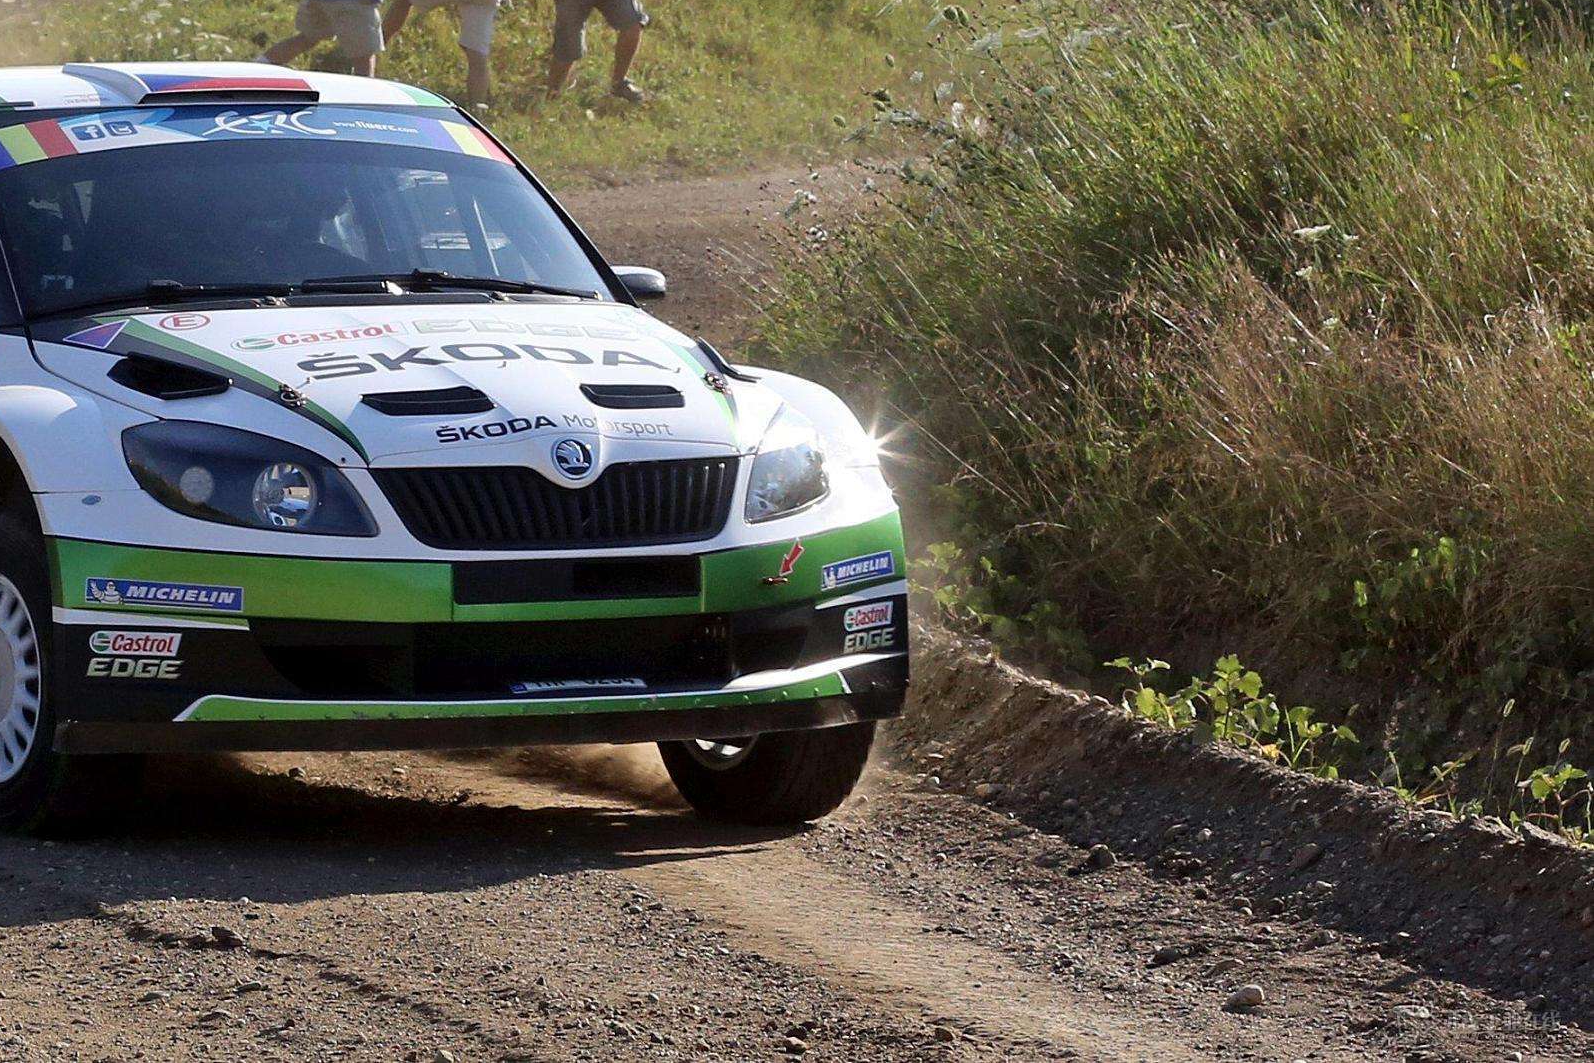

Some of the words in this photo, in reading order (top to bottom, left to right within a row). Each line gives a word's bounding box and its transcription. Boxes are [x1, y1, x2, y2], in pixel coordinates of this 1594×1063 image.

[277, 323, 399, 346] Castrol
[412, 318, 639, 341] EDGE
[297, 343, 673, 380] ŠKODA
[436, 414, 557, 443] ŠKODA
[837, 556, 889, 579] MICHELIN
[126, 585, 235, 604] MICHELIN
[854, 604, 889, 627] Castrol
[112, 633, 174, 653] Castrol
[843, 627, 896, 654] EDGE
[86, 657, 184, 679] EDGE
